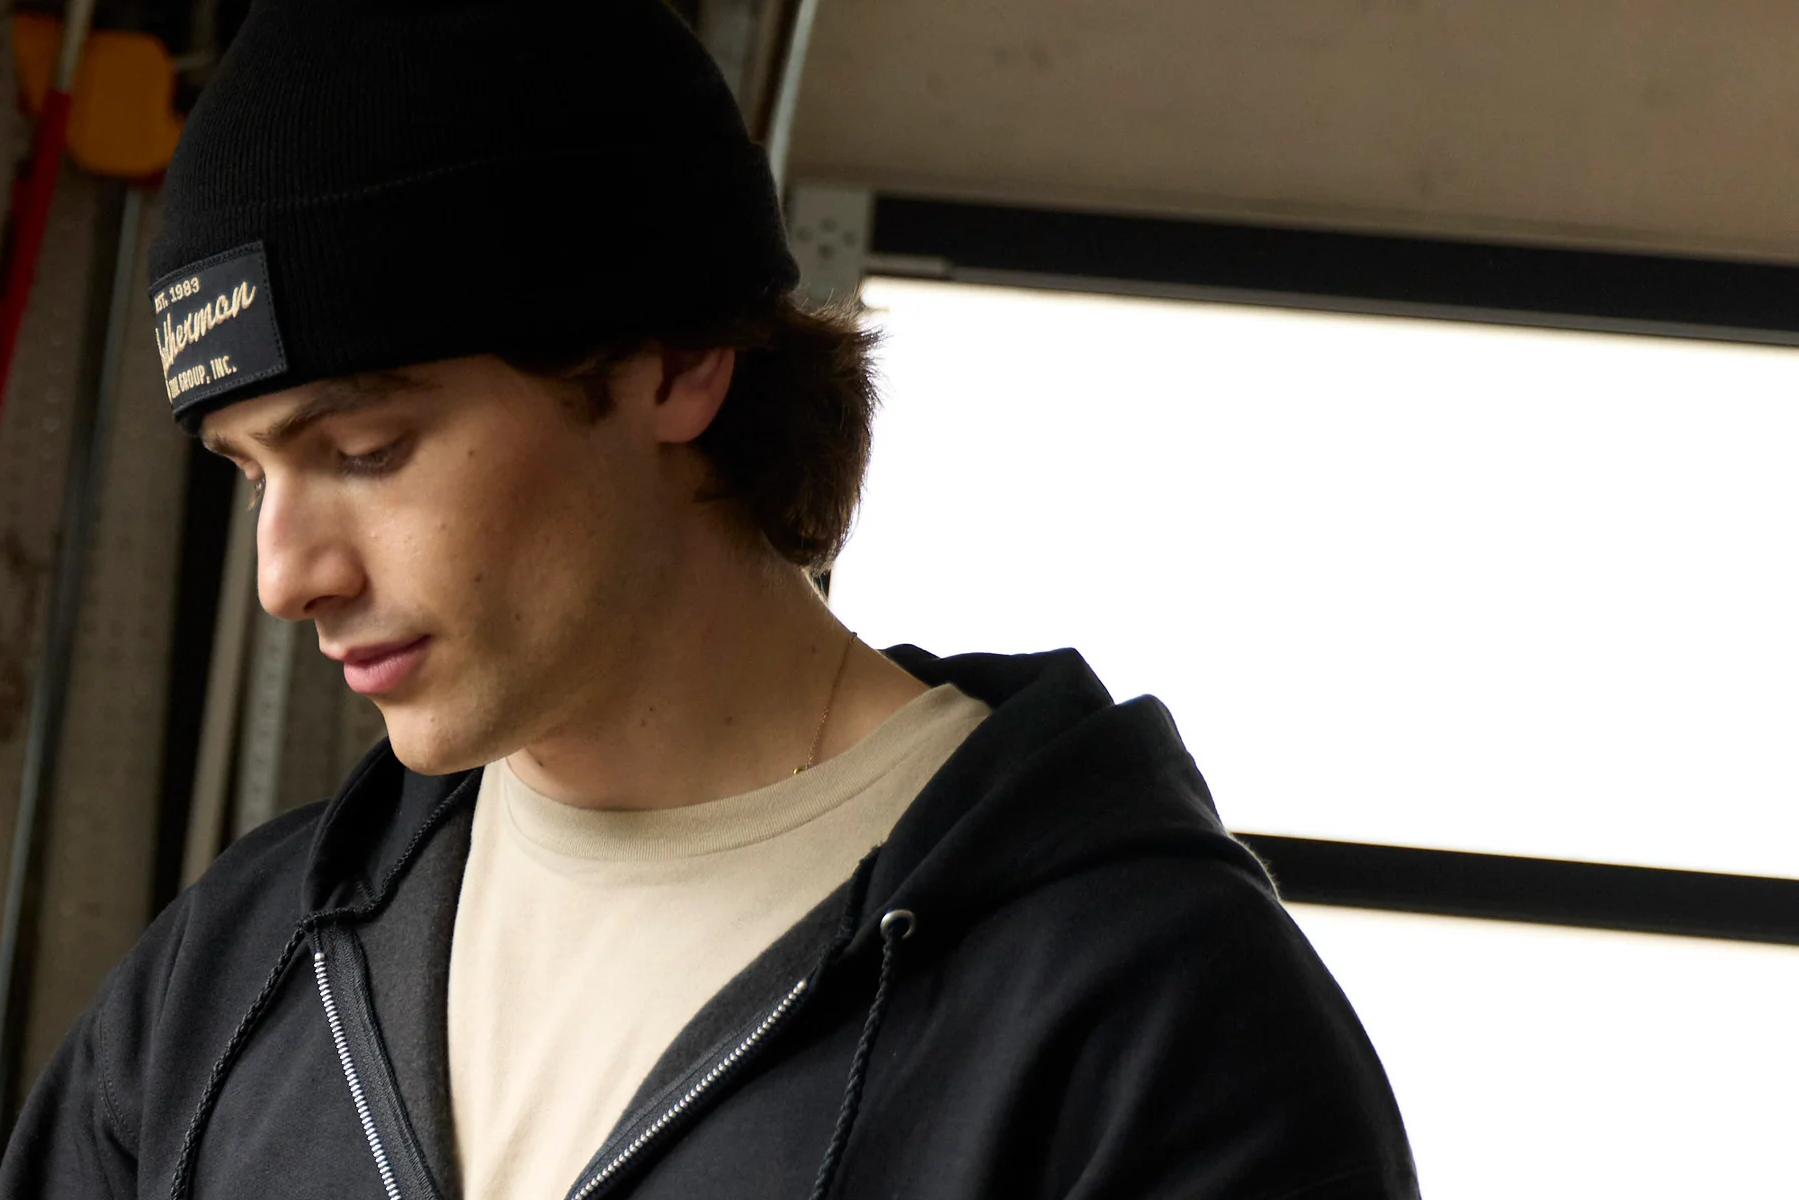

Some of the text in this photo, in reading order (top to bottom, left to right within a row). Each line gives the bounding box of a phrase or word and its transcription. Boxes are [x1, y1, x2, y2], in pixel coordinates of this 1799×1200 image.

[169, 276, 200, 303] 1983
[155, 280, 257, 375] therman
[178, 364, 211, 392] GROUP,
[210, 355, 238, 380] INC.
